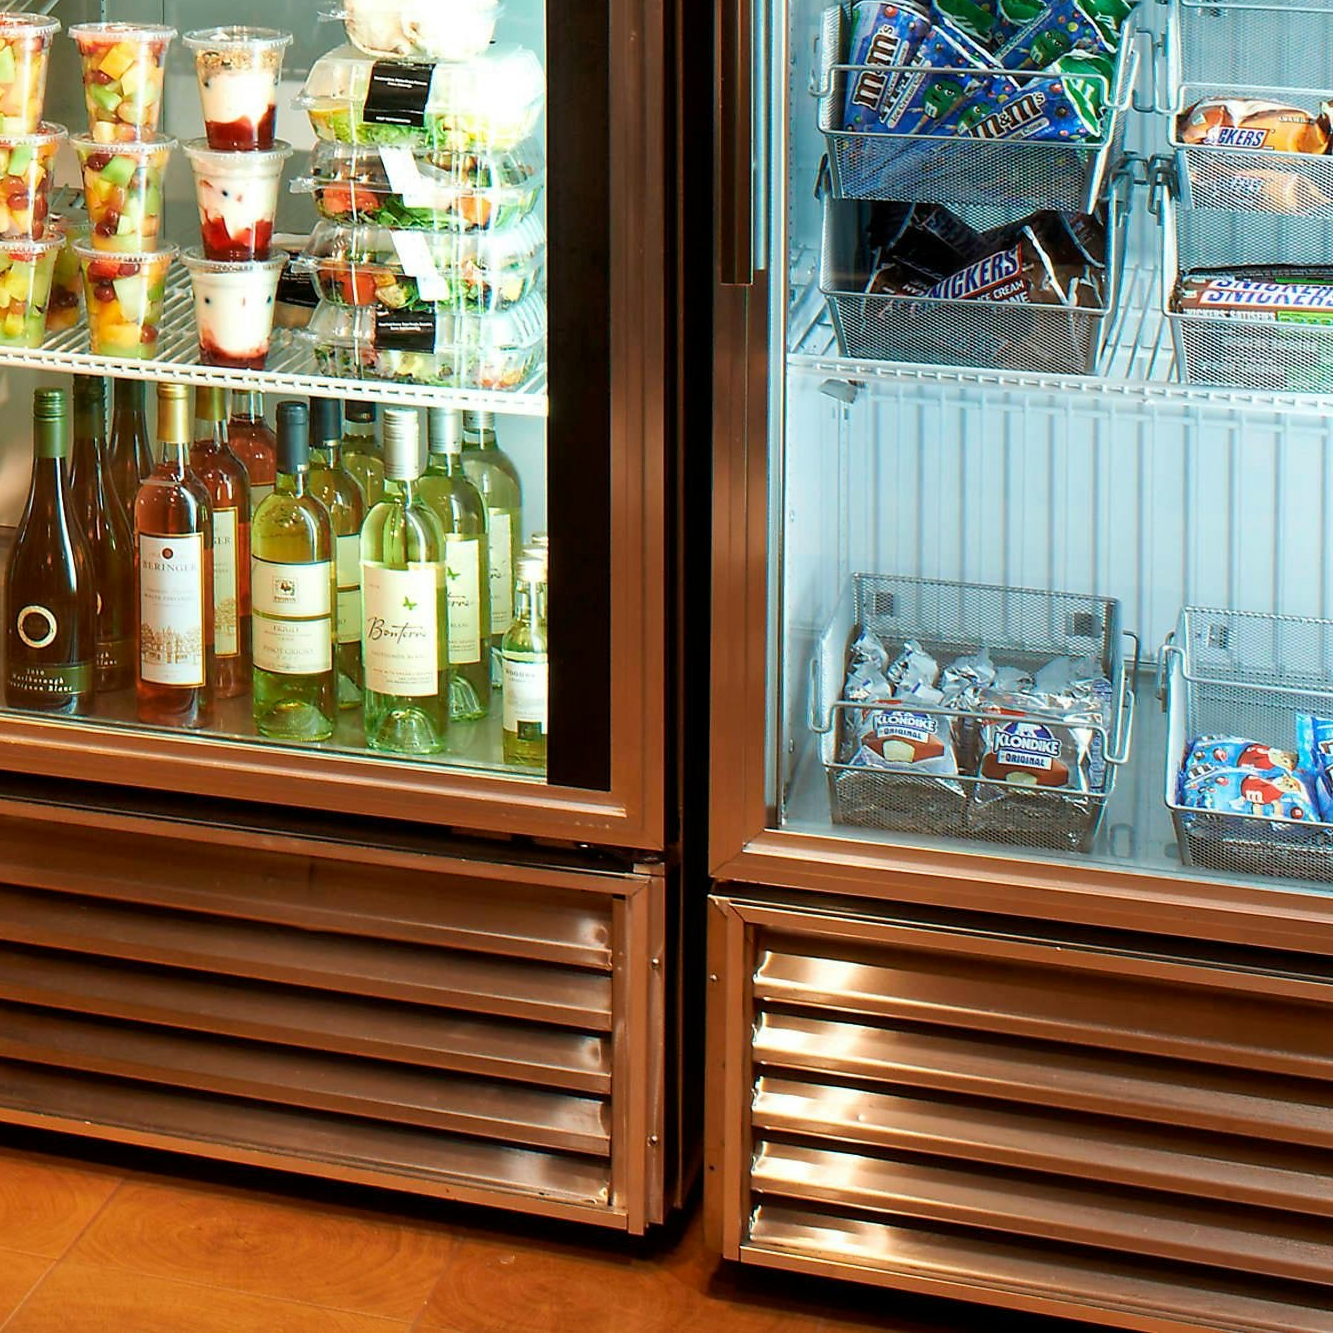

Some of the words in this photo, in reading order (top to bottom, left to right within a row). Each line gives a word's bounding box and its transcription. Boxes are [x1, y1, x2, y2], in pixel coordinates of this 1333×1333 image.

[993, 279, 1025, 299] CREAM
[874, 714, 937, 733] KLONDIKE
[994, 732, 1061, 755] KLONDIKE
[1005, 754, 1045, 767] ORIGINAL
